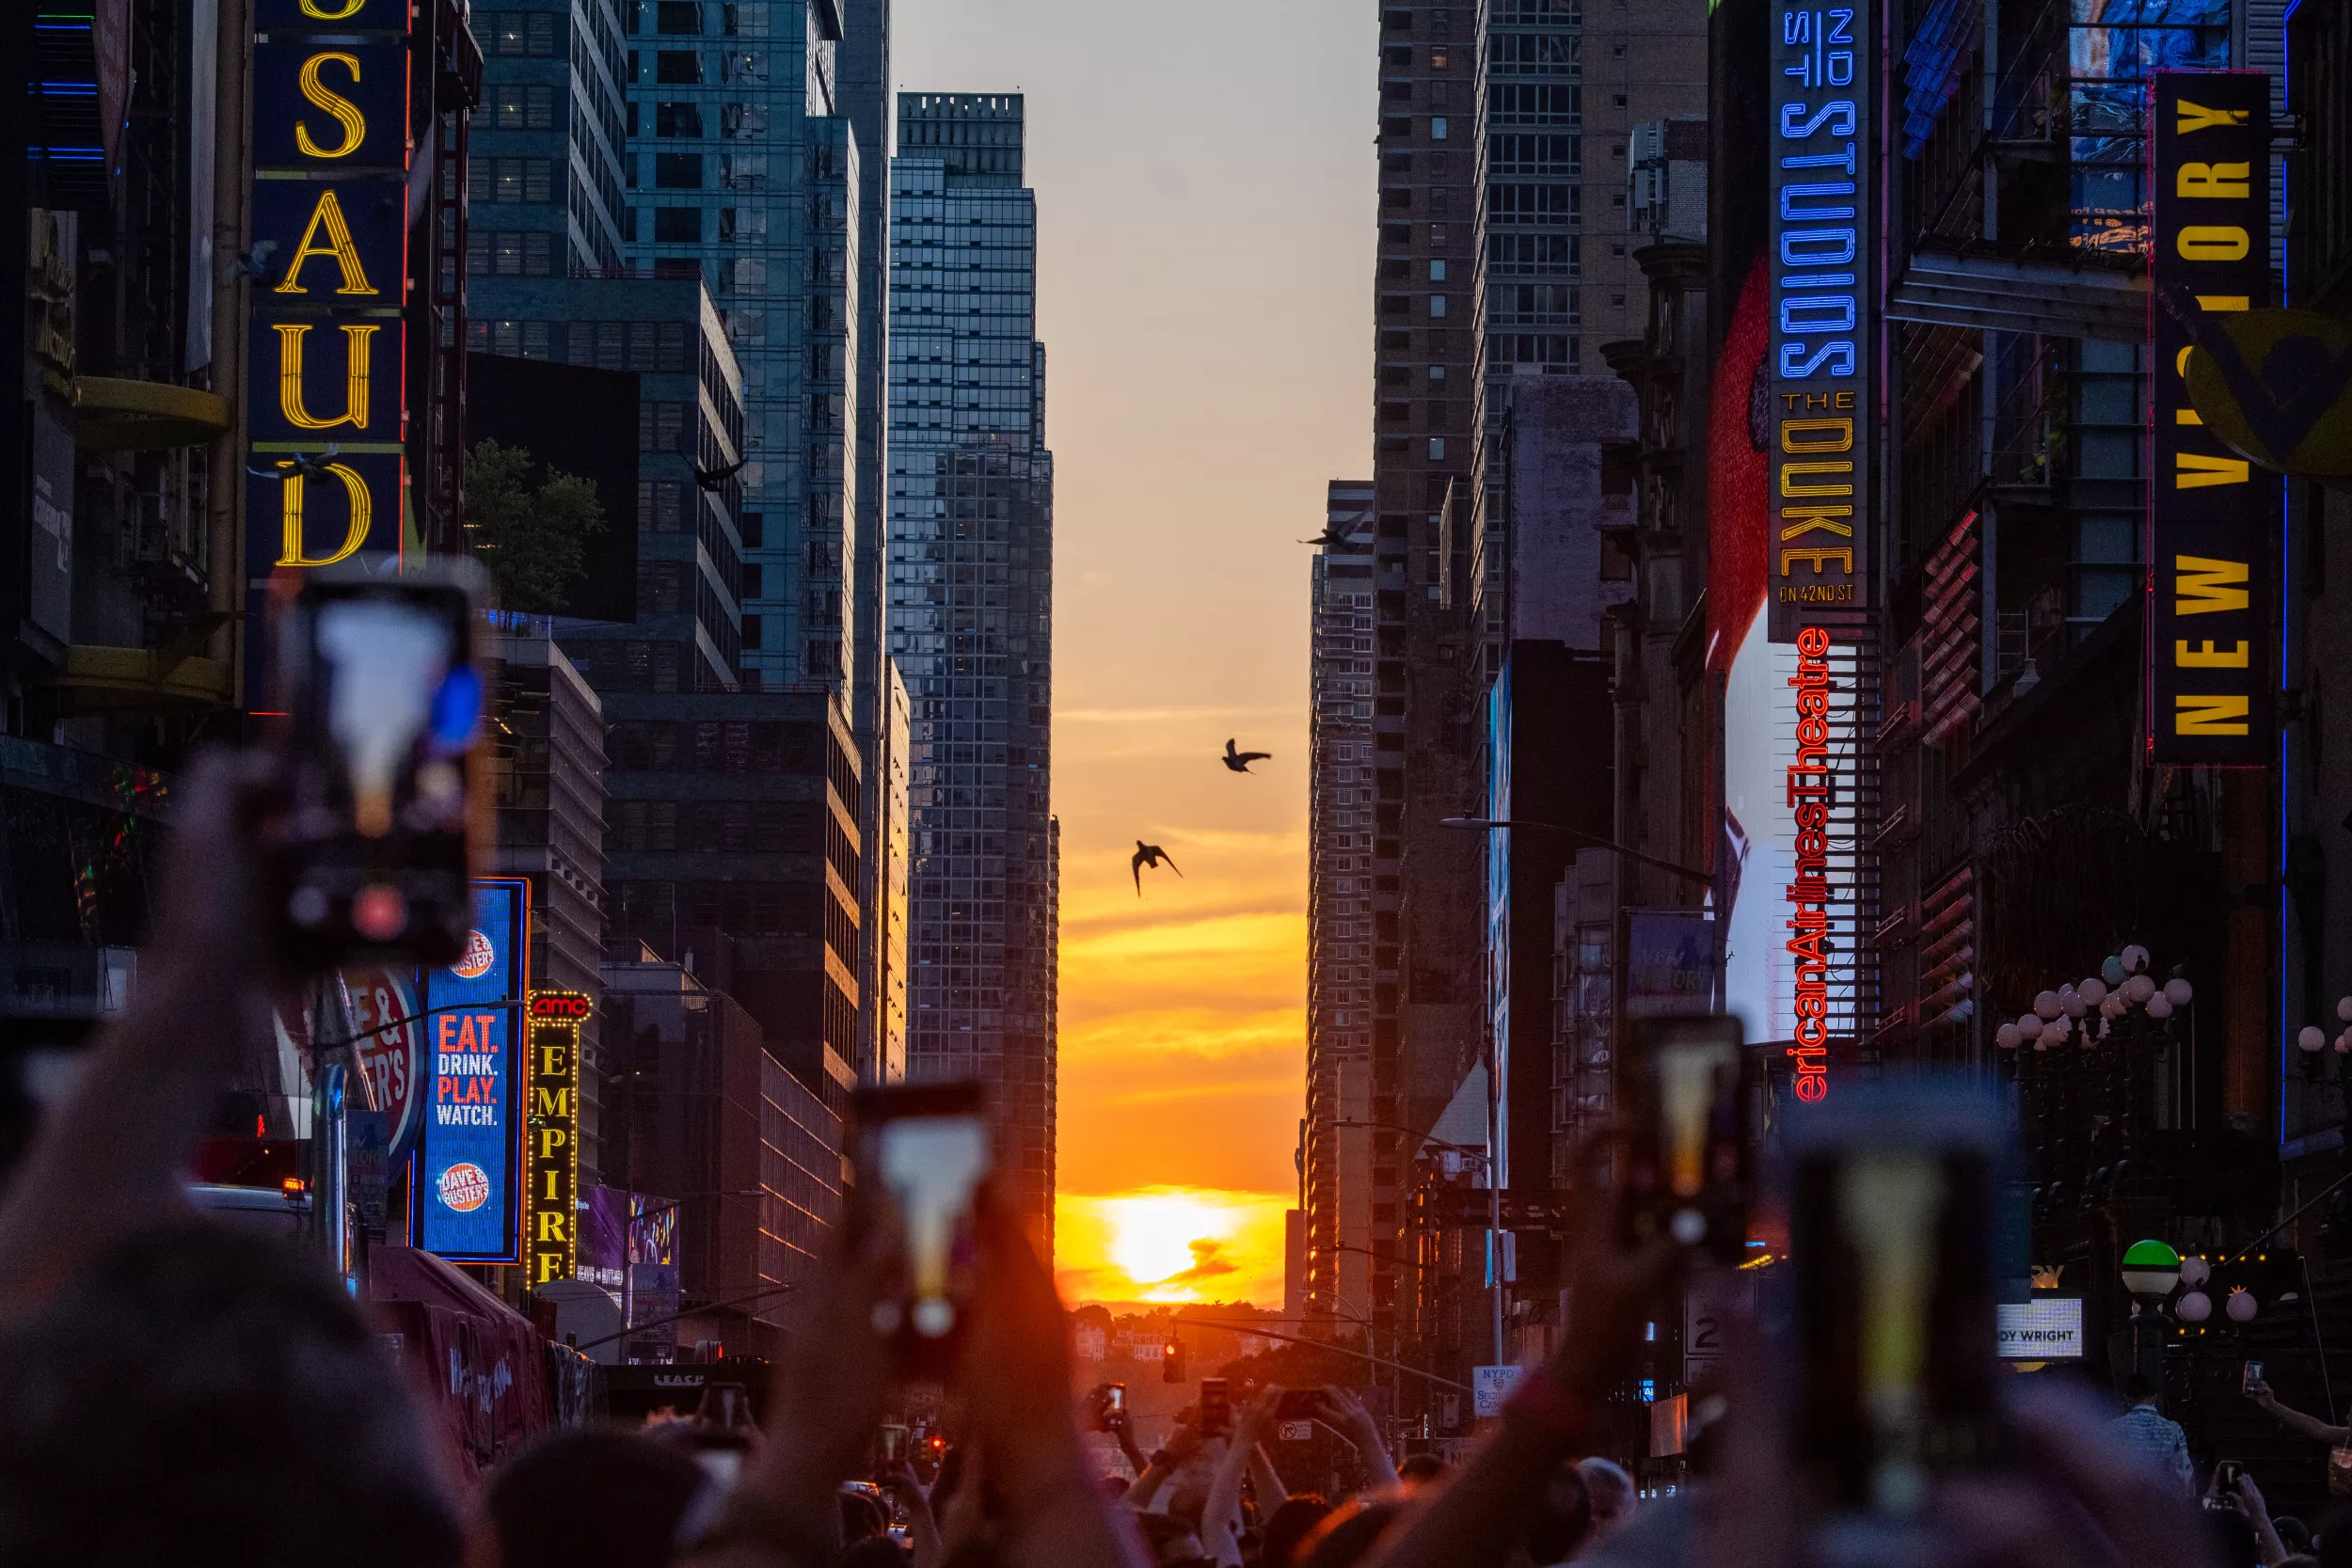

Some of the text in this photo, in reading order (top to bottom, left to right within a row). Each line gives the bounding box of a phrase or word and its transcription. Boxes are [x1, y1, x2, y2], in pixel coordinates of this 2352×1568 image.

[1780, 100, 1856, 378] STUDIOS
[272, 0, 380, 568] SAUD
[1779, 391, 1856, 411] THE
[1780, 417, 1854, 577] DUKE
[1779, 584, 1853, 603] ON 42ND ST
[2175, 554, 2249, 736] NEW
[532, 997, 586, 1015] amc
[439, 1014, 500, 1053] EAT.
[437, 1053, 499, 1076] DRINK.
[437, 1076, 497, 1104] PLAY.
[437, 1104, 497, 1126] WATCH.
[534, 1045, 570, 1283] EMPIRE
[1695, 1317, 1720, 1348] 2
[2020, 1330, 2074, 1341] WRIGHT
[1483, 1370, 1514, 1378] NYPD
